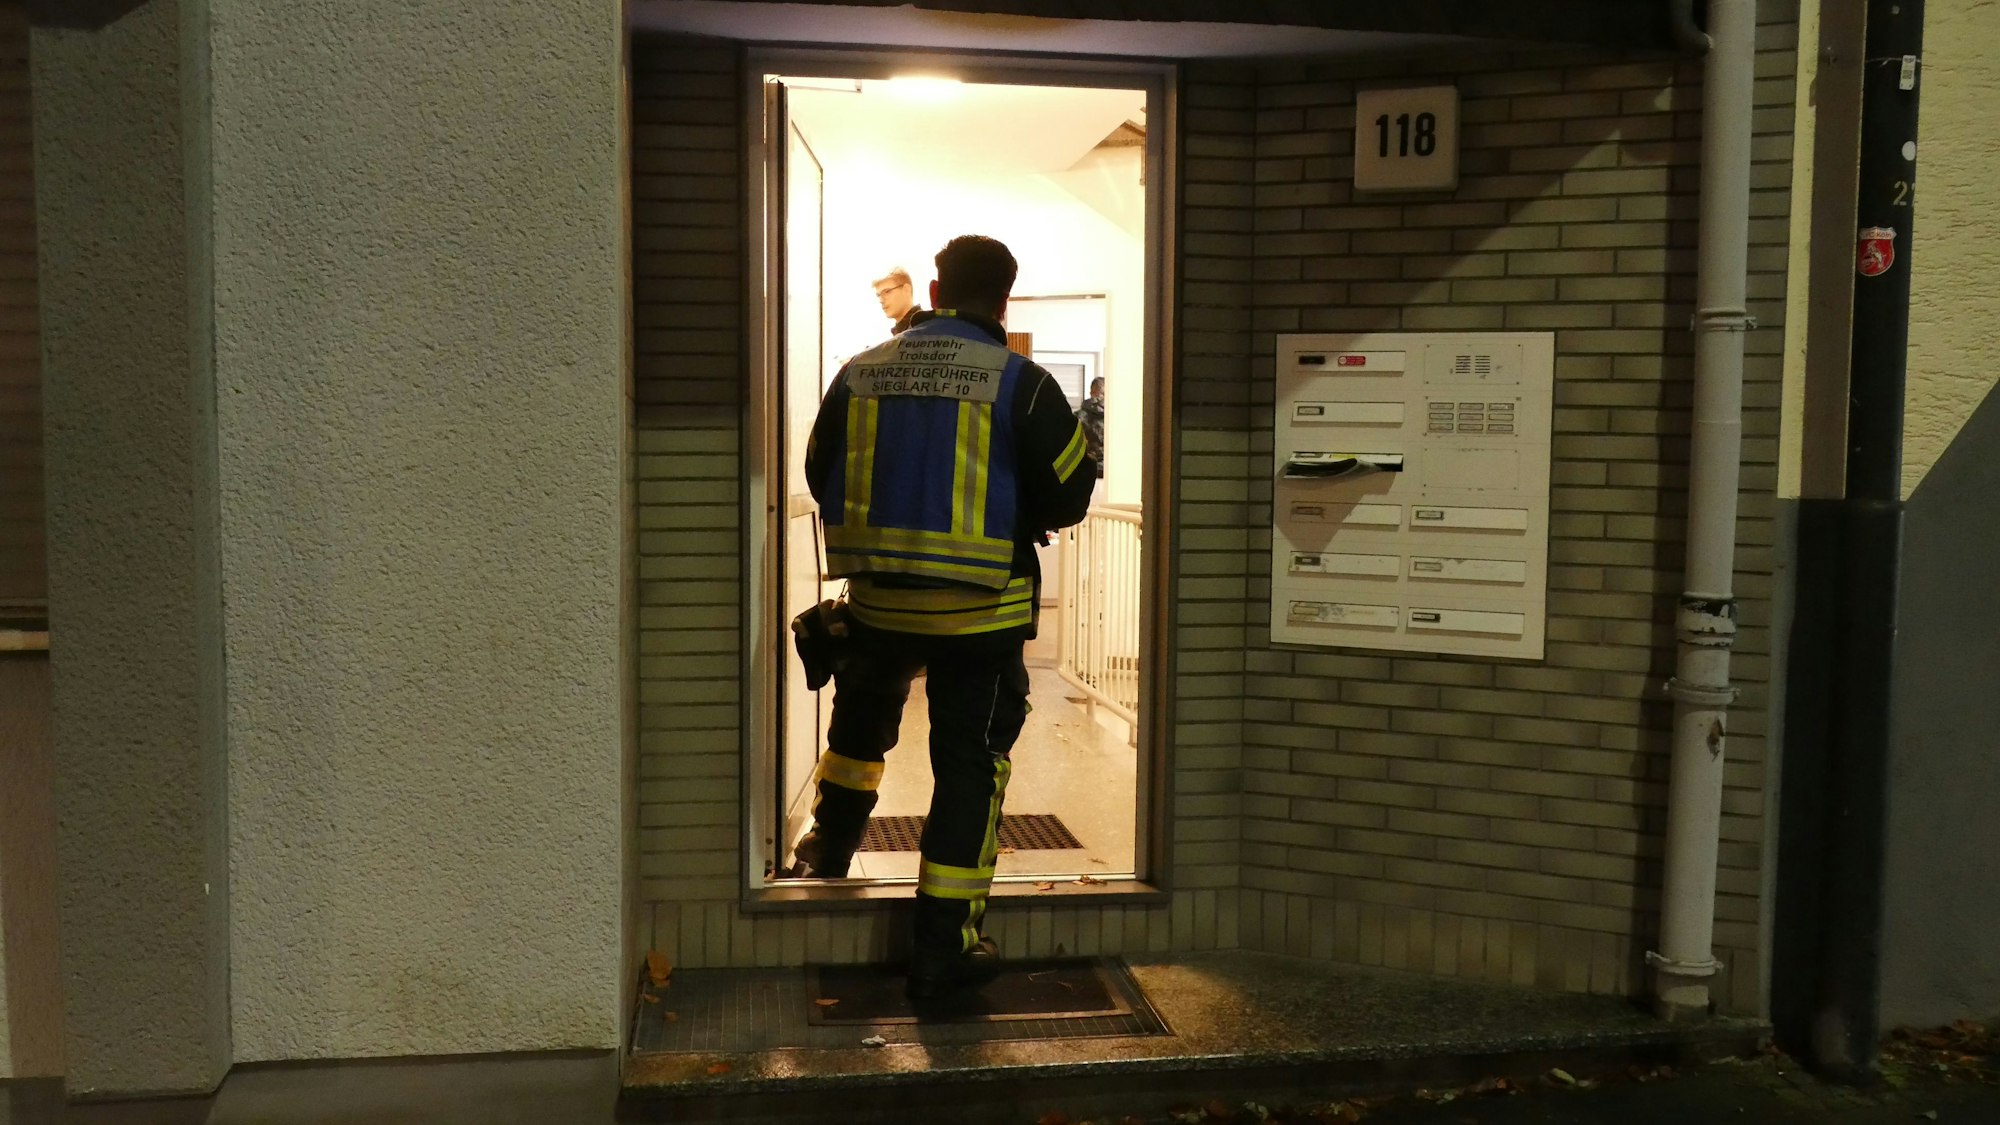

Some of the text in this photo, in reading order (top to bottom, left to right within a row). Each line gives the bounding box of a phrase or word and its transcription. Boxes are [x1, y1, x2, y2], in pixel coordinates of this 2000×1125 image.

[1375, 111, 1436, 158] 118
[897, 339, 965, 350] Feuerwehr
[899, 351, 959, 361] Troisdorf
[859, 366, 989, 383] FAHRZEUGFÜHRER
[872, 381, 970, 396] SIEGLAR LF 10
